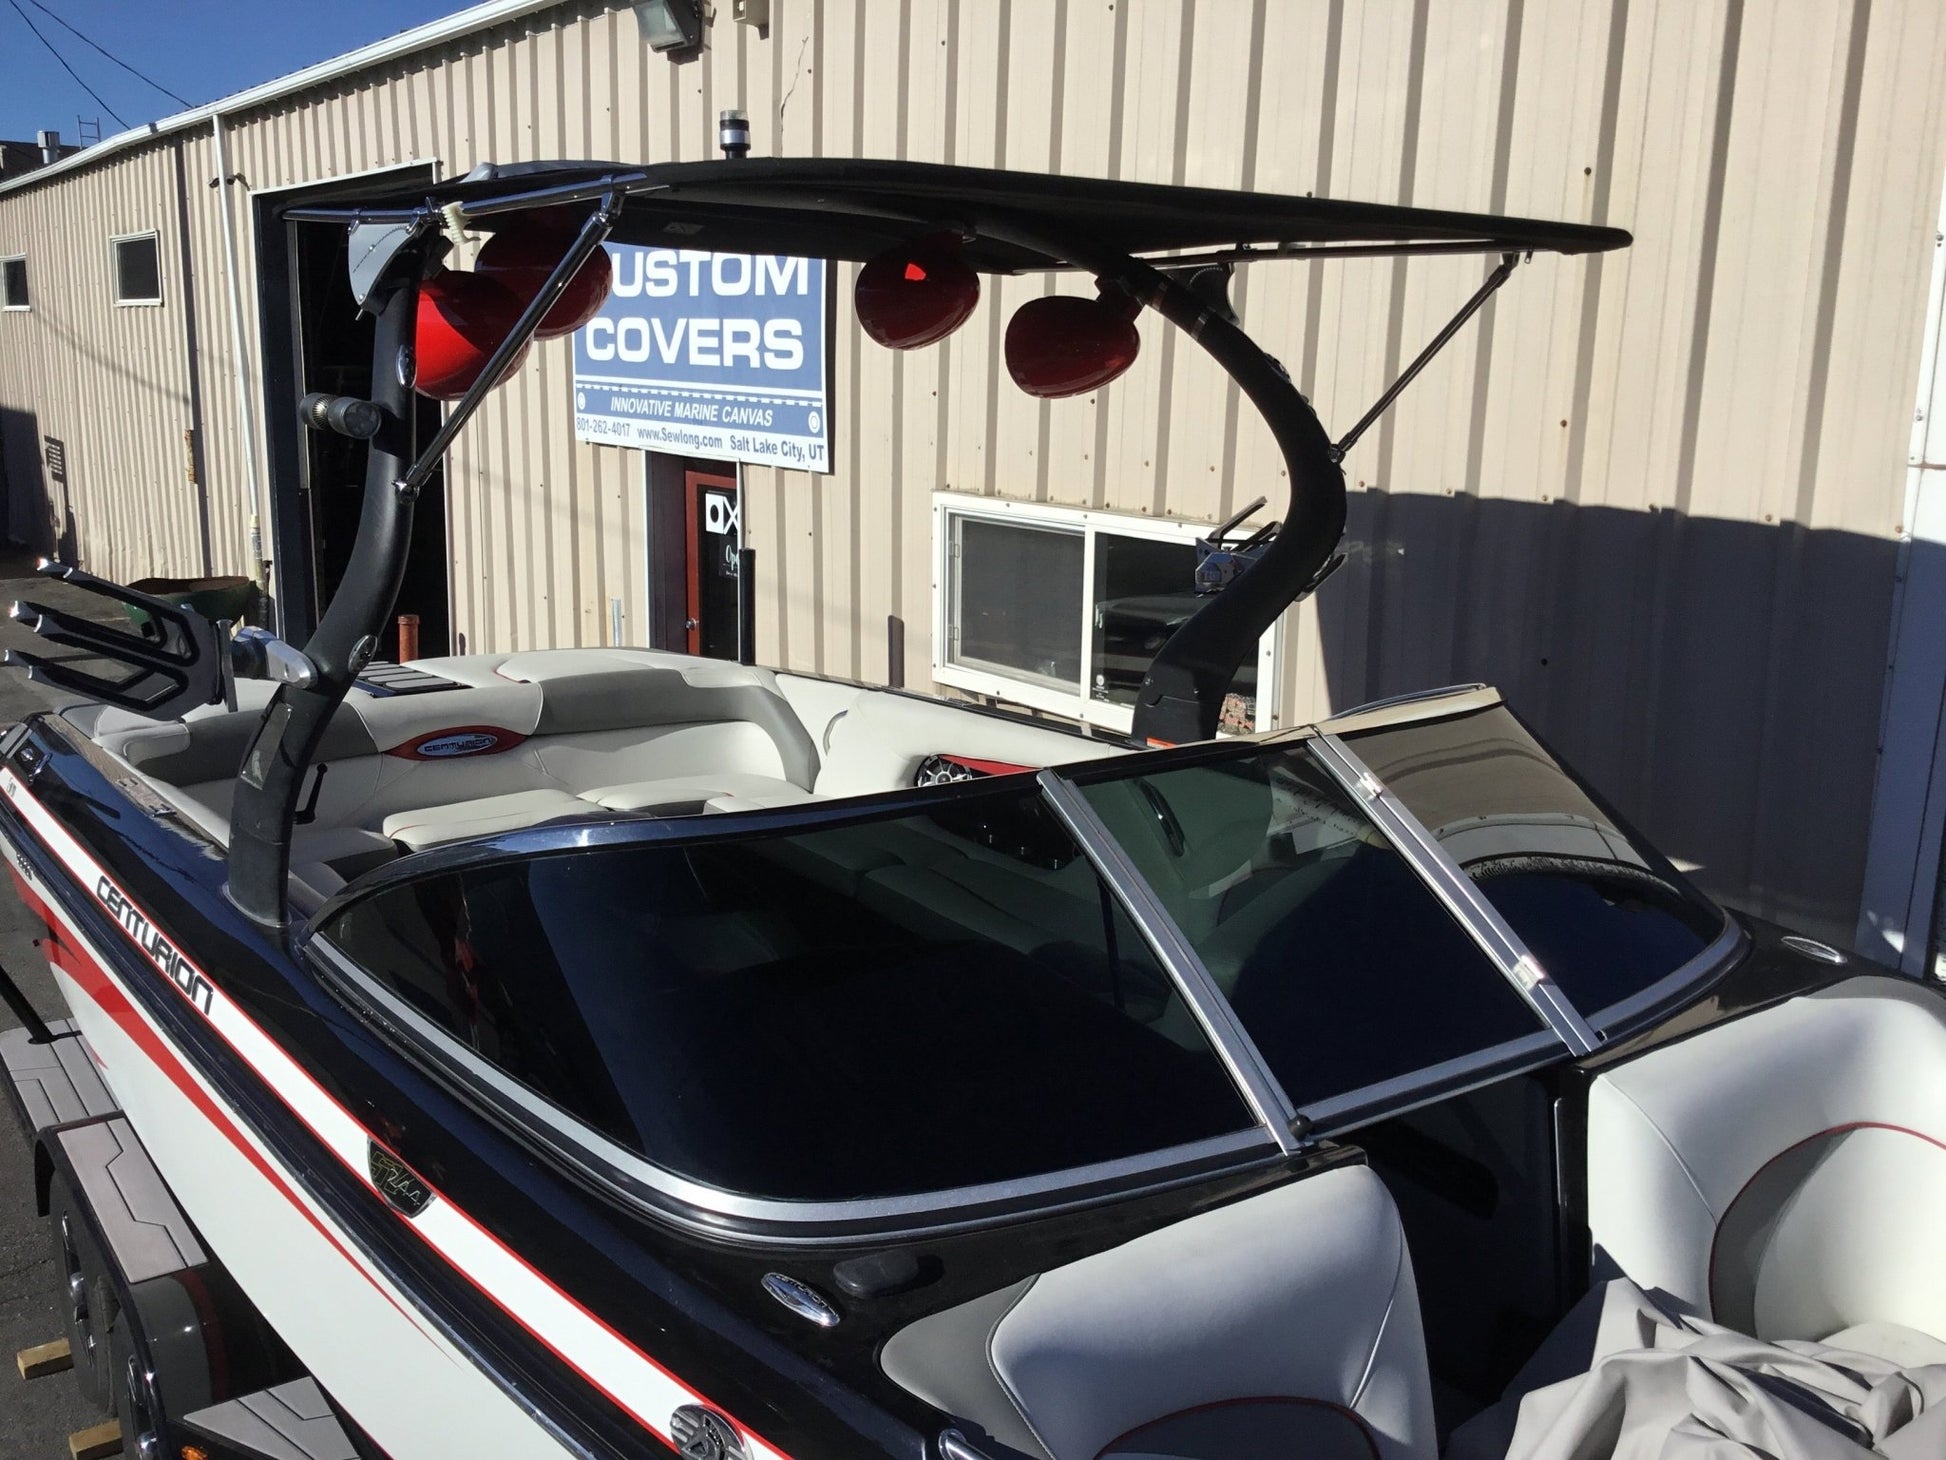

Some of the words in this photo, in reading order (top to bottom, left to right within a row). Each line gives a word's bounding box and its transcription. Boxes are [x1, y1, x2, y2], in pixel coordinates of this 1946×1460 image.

[611, 249, 808, 298] USTOM
[585, 316, 804, 370] COVERS
[610, 396, 672, 417] INNOVATIVE
[674, 401, 719, 421] MARINE
[722, 405, 773, 427] CANVAS
[576, 416, 631, 438] 801-262-4017
[637, 427, 723, 450] www.Sewlong.com
[730, 434, 750, 452] Salt
[752, 436, 778, 455] Lake
[781, 440, 806, 463] City,
[808, 443, 824, 461] UT
[424, 737, 491, 752] CENTURION
[97, 875, 214, 1016] CENTURION
